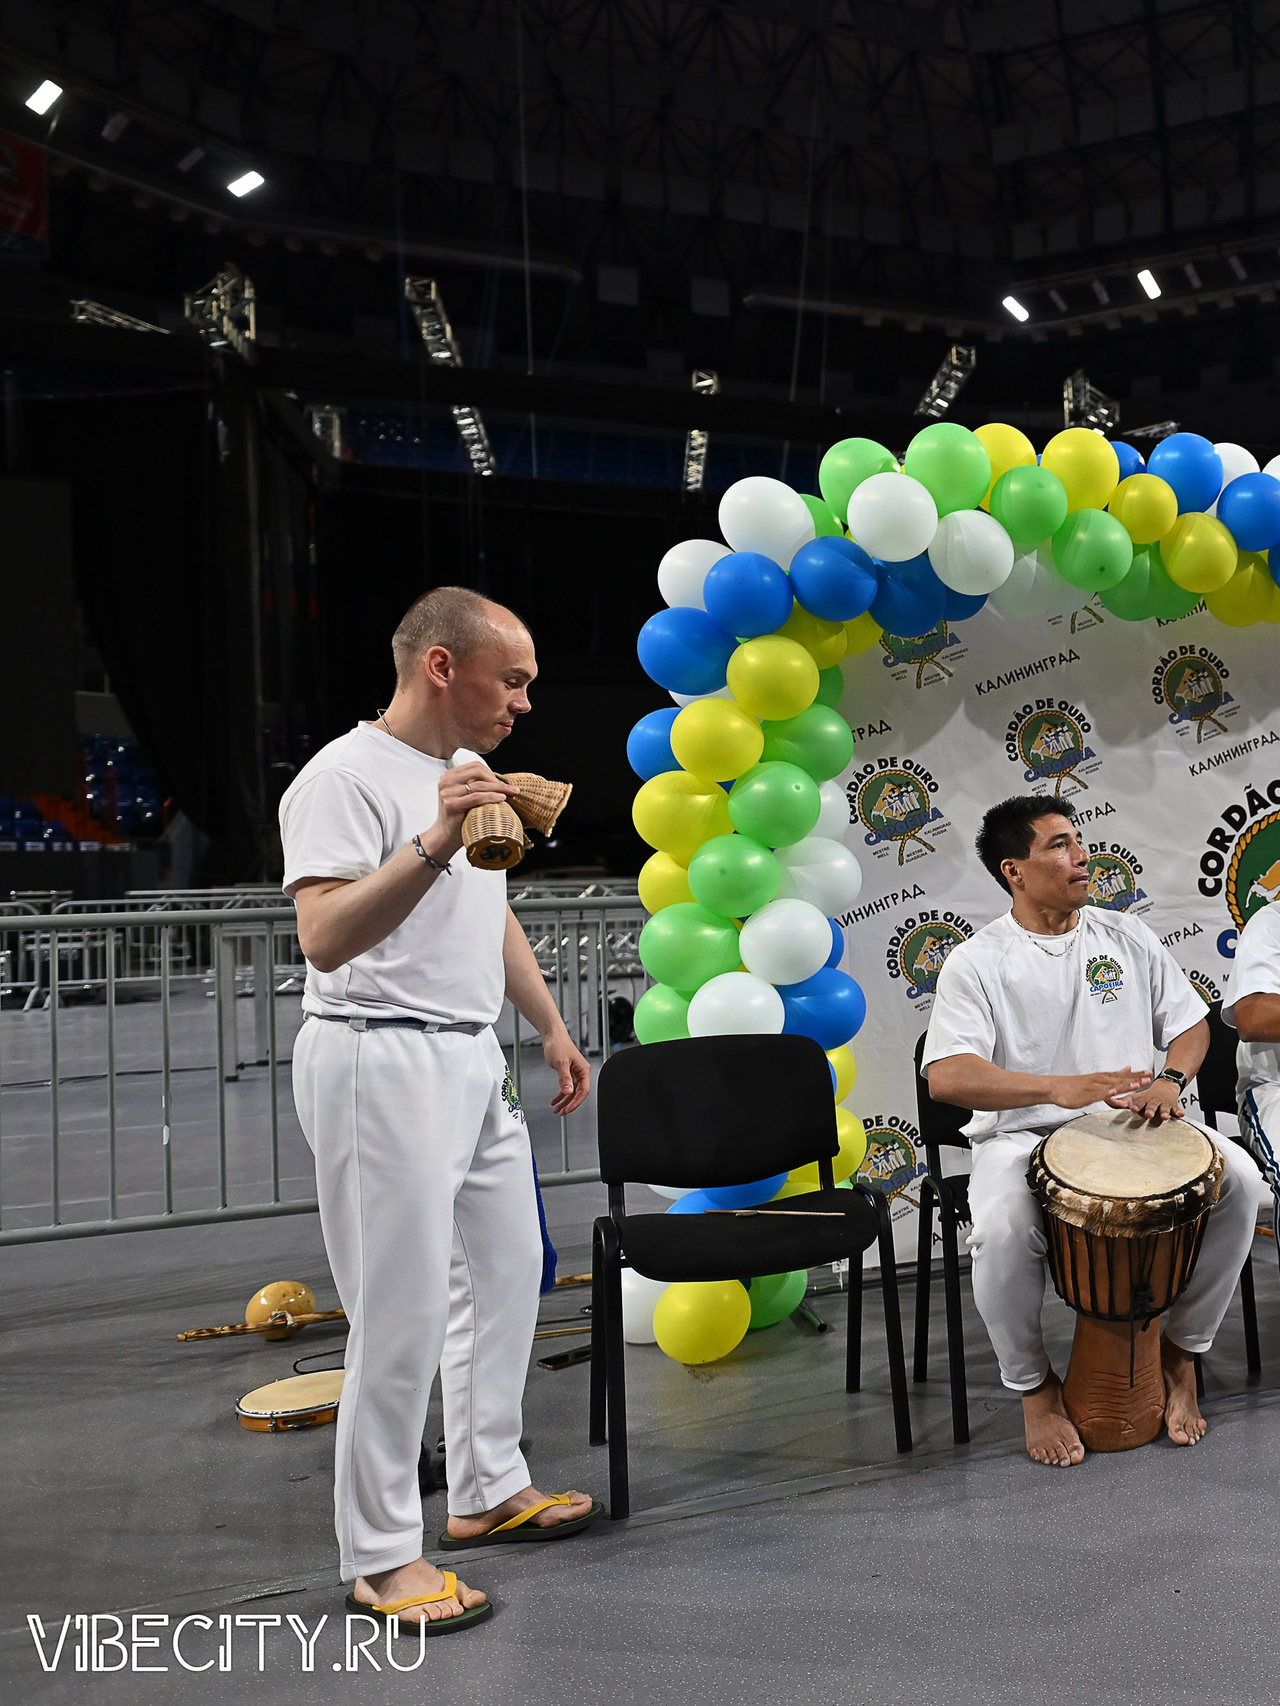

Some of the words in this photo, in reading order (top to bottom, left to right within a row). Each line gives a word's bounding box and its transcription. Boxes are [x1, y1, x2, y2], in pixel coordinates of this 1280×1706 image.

[975, 648, 1080, 696] КАЛИНИНГРАД
[1152, 649, 1178, 705] CORDÃO
[1178, 645, 1196, 656] DE
[1199, 647, 1230, 679] OURO
[1005, 704, 1033, 762] CORDÃO
[1035, 698, 1054, 710] DE
[1058, 700, 1091, 733] OURO
[1024, 746, 1096, 782] CAPOEIRA
[1188, 731, 1280, 777] КАЛИНИНГРАД
[877, 757, 898, 770] DE
[902, 759, 939, 793] OURO
[864, 807, 944, 846] CAPOEIRA
[1088, 842, 1106, 854] DE
[1110, 843, 1143, 875] OURO
[886, 917, 917, 979] CORDÃO
[918, 910, 939, 923] DE
[1089, 980, 1124, 992] CAPOEIRA
[1190, 969, 1221, 1000] OURO
[862, 1115, 884, 1130] DE
[888, 1116, 925, 1148] OURO
